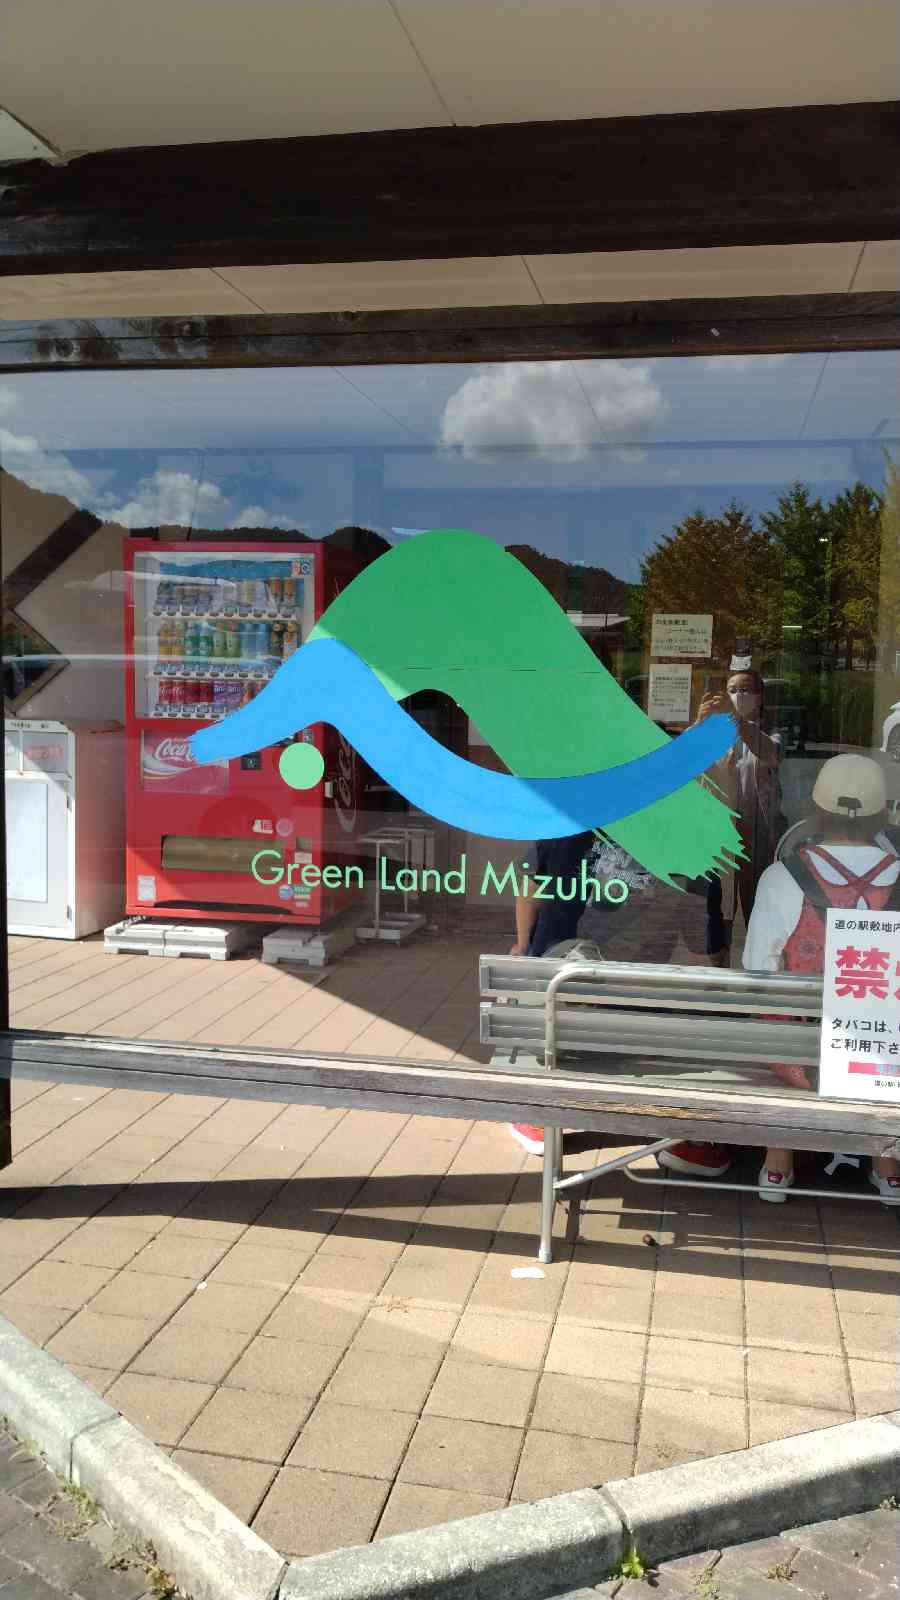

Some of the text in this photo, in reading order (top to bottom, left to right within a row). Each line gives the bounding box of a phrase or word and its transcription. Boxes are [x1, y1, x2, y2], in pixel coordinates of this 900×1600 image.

[251, 849, 630, 903] Green Land Mizuho
[834, 945, 900, 1000] 禁
[831, 1017, 900, 1034] タバコは、
[830, 1038, 900, 1055] ご利用下さ
